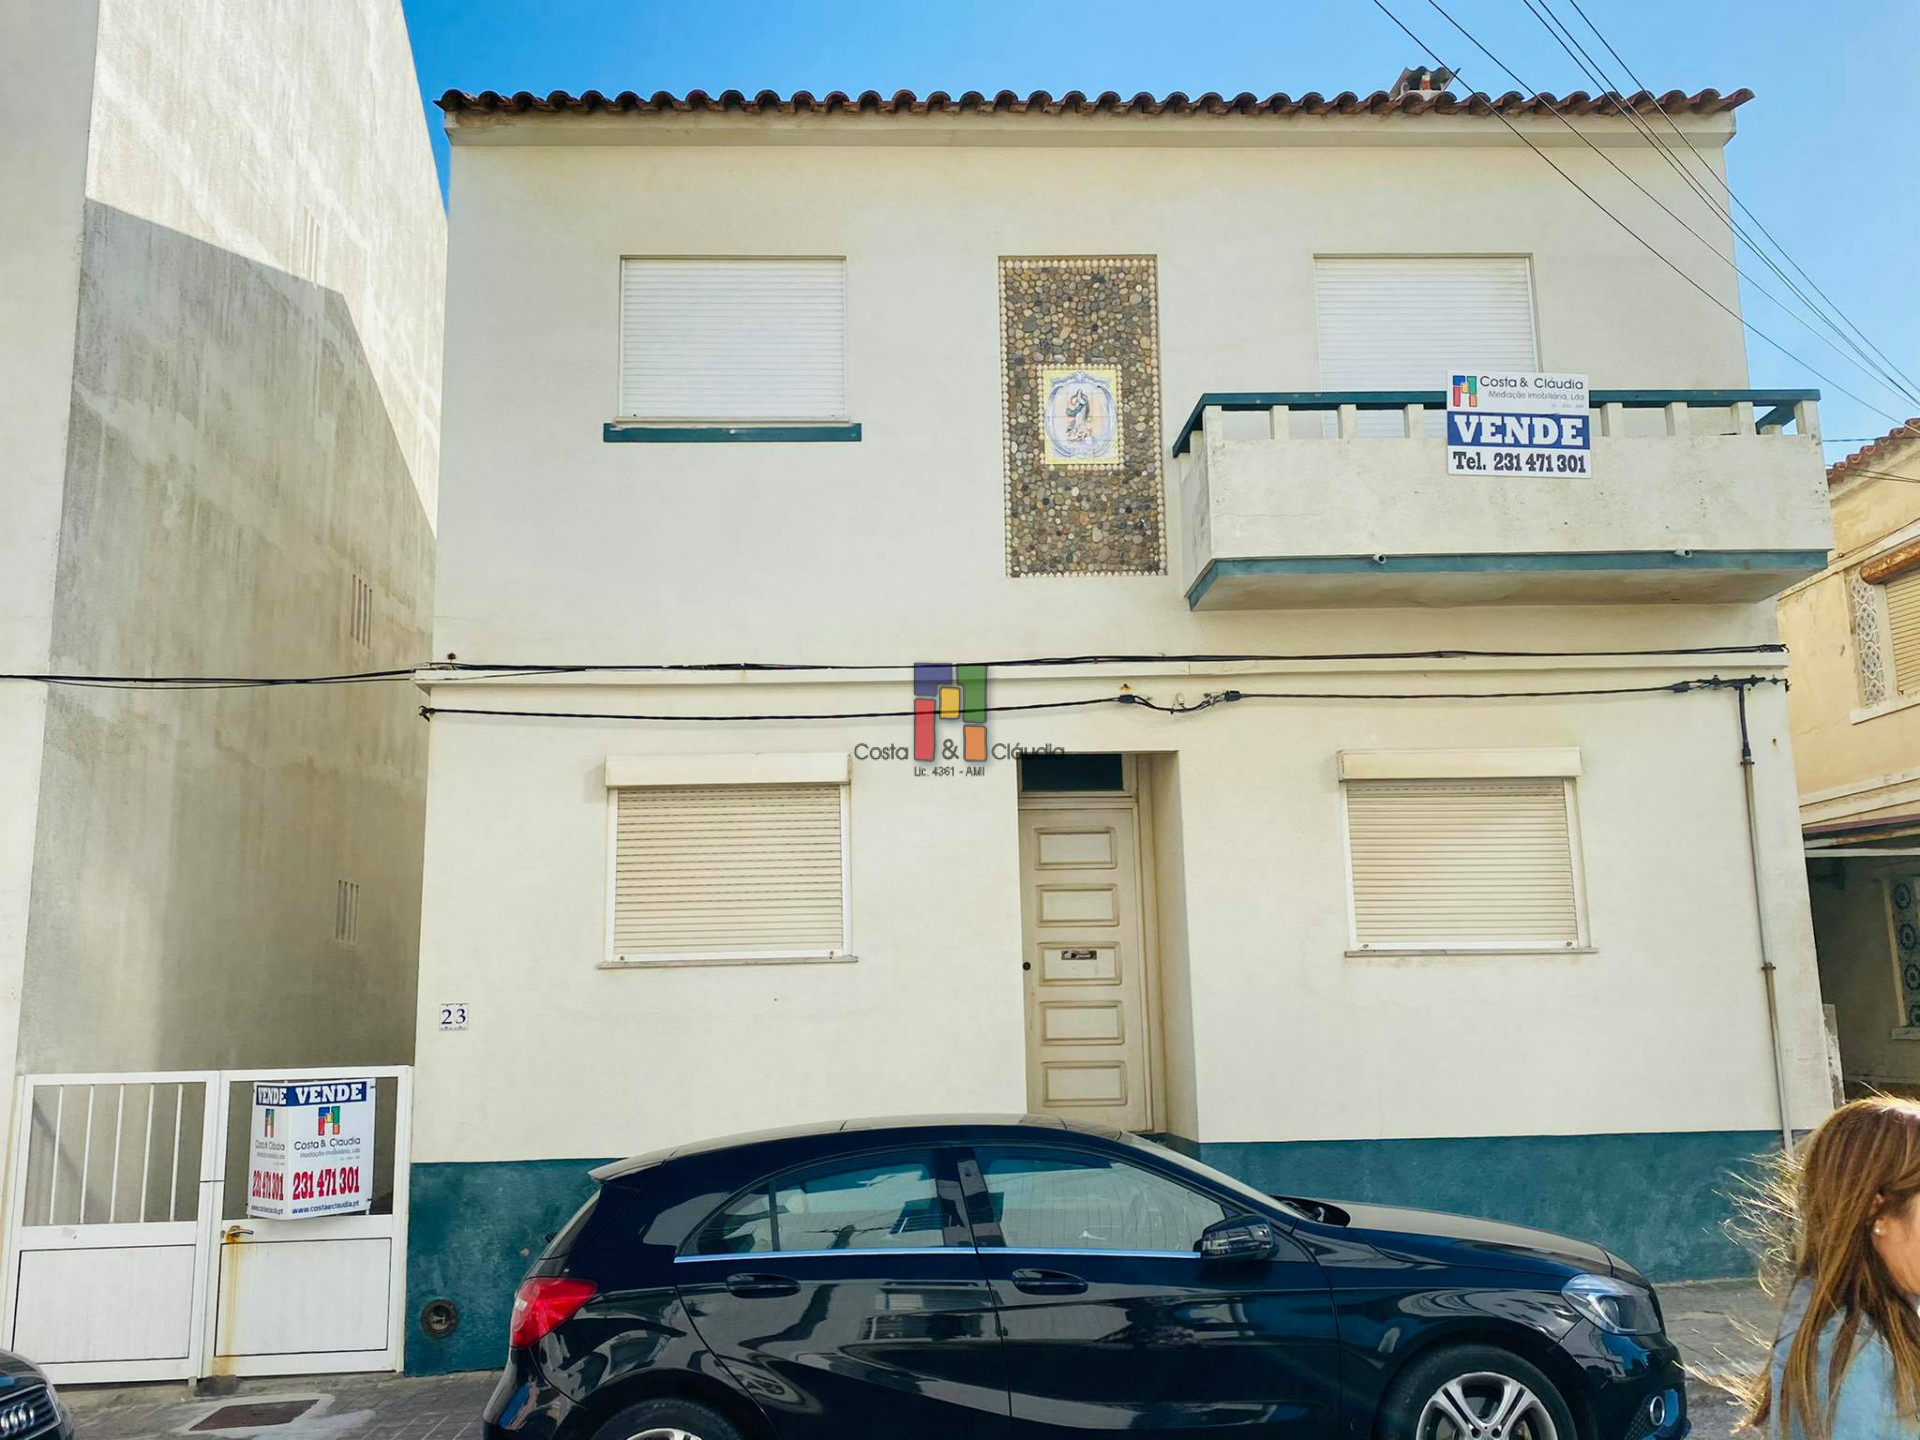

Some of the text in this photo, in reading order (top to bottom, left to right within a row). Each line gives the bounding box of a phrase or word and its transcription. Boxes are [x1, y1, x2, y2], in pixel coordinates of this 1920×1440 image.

[1480, 375, 1583, 389] Costa & Cláudia
[1453, 414, 1584, 446] VENDE
[1453, 451, 1586, 473] Tel. 231 471 301
[440, 1008, 466, 1025] 23
[257, 1087, 287, 1105] VENDE
[295, 1084, 362, 1104] VENDE
[294, 1140, 319, 1151] Costa
[320, 1139, 326, 1148] &
[292, 1166, 360, 1200] 231 471 301
